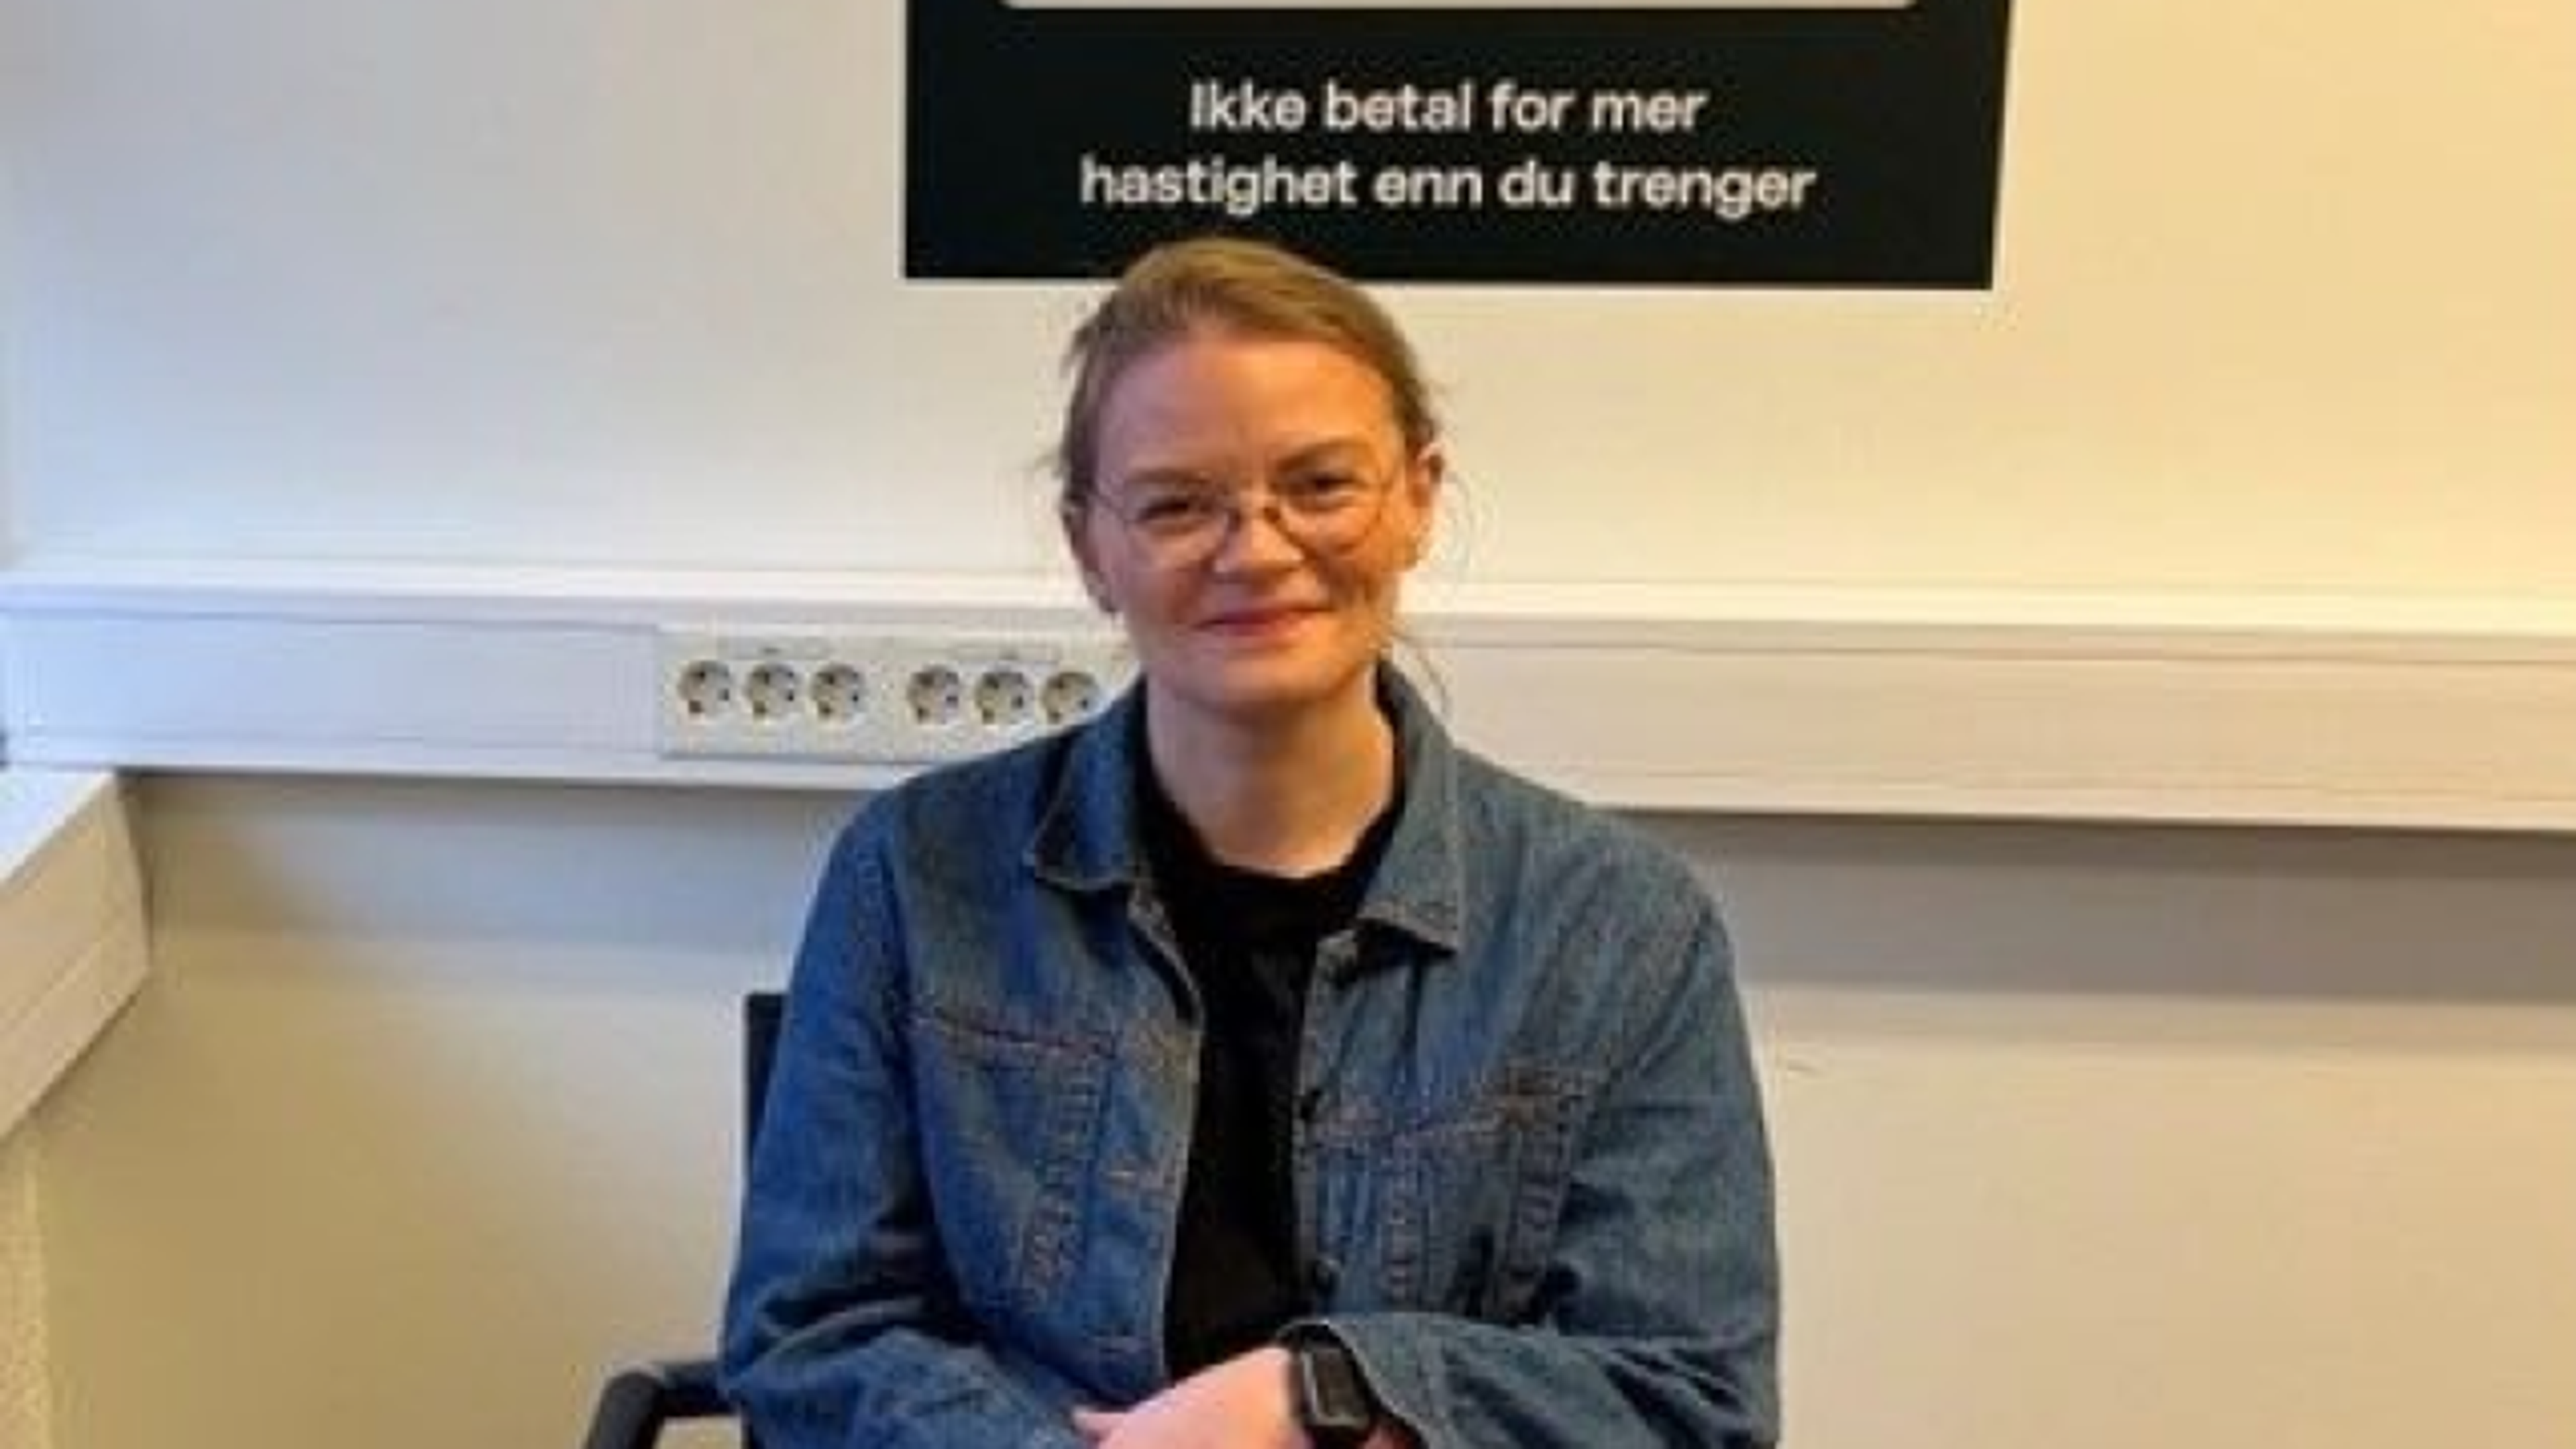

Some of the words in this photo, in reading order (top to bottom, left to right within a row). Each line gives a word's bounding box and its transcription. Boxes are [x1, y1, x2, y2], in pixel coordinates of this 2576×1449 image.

[1190, 80, 1307, 130] Ikke
[1324, 80, 1472, 131] betal
[1489, 81, 1575, 131] for
[1591, 91, 1707, 131] mer
[1081, 157, 1357, 217] hastighet
[1373, 167, 1483, 206] enn
[1497, 159, 1575, 207] du
[1592, 161, 1817, 220] trenger
